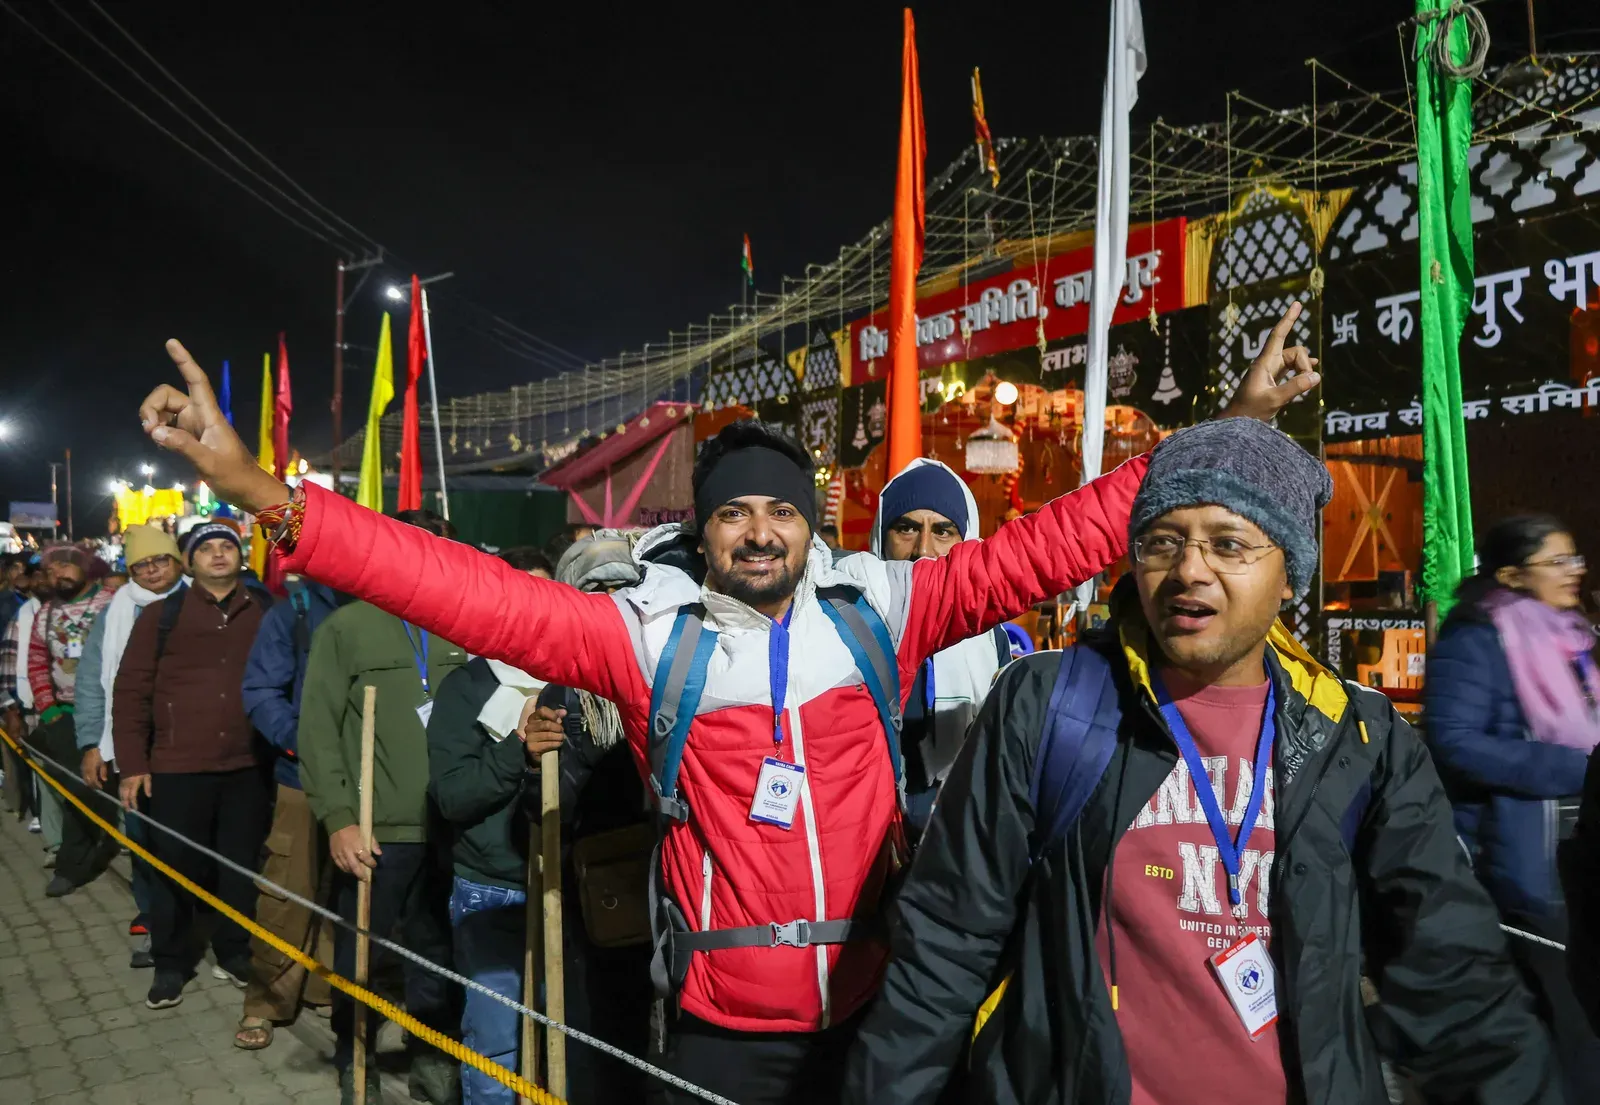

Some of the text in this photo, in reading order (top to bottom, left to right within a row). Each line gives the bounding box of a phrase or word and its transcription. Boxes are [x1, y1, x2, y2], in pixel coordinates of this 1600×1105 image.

[1054, 249, 1162, 307] कापुर
[1325, 377, 1600, 435] शिव सेक समि
[1145, 864, 1174, 880] ESTD
[1180, 919, 1222, 935] UNITED
